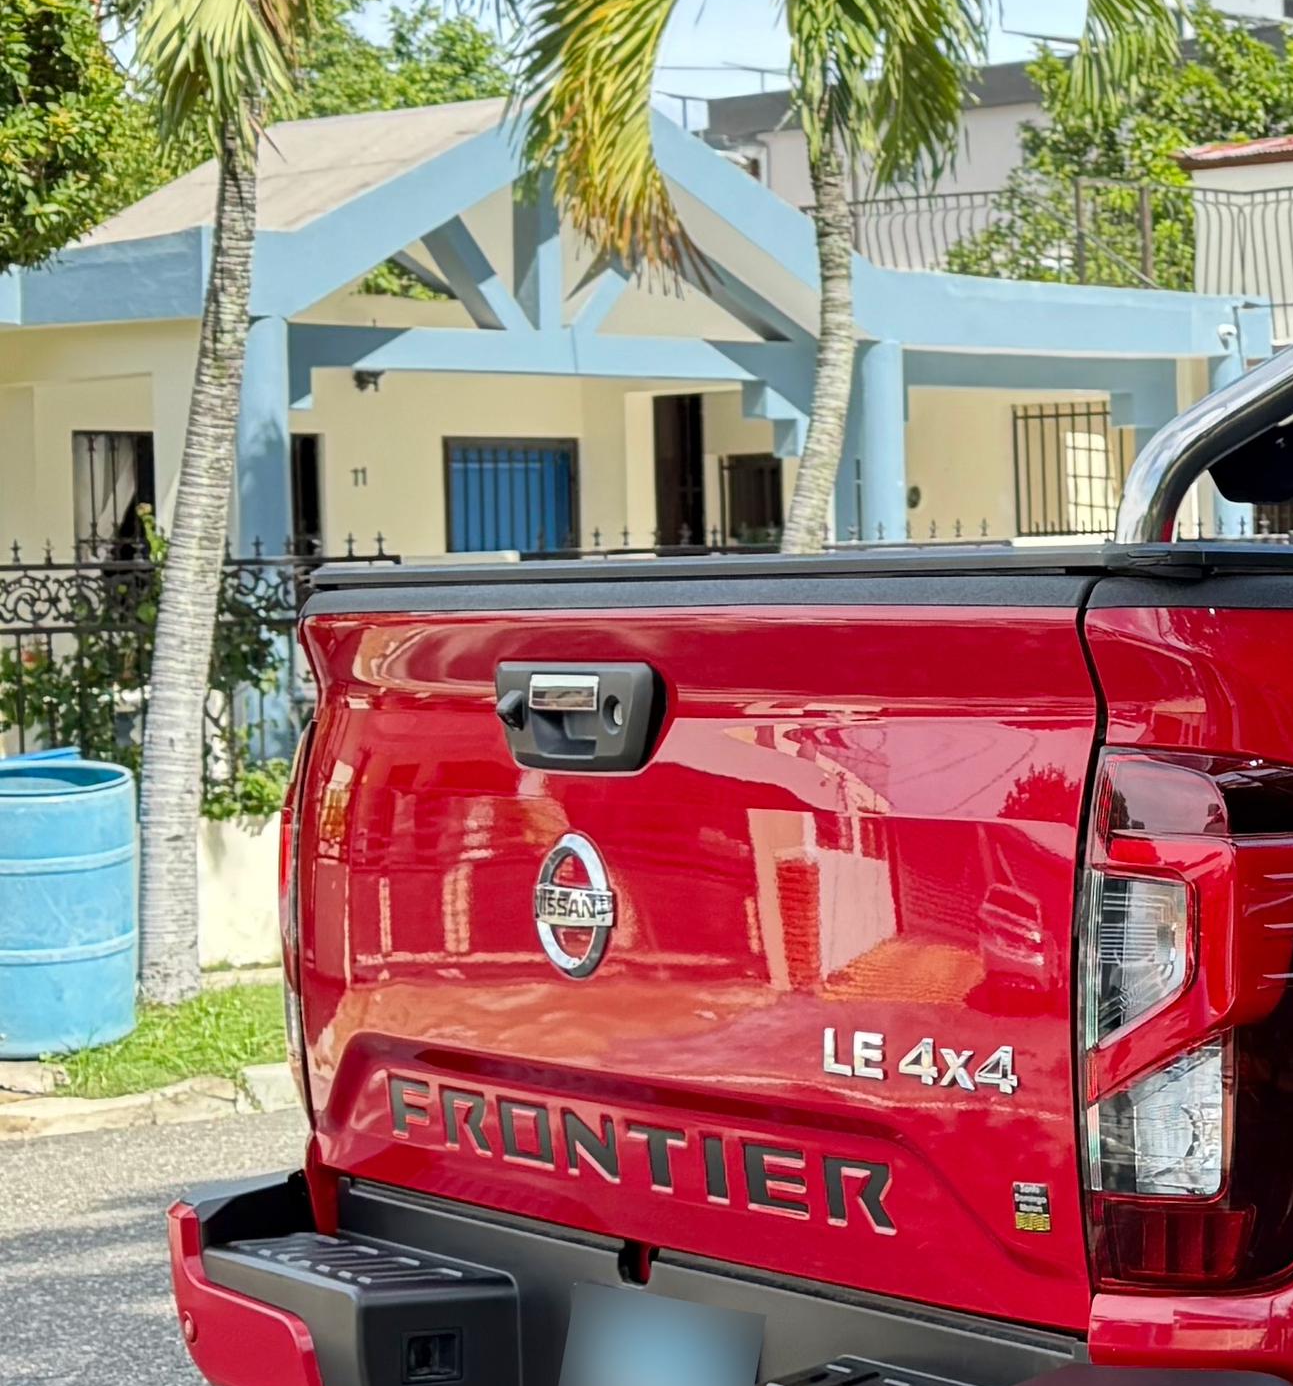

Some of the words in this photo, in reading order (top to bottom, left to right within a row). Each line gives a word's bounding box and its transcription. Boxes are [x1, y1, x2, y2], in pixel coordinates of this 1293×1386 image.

[350, 467, 367, 487] 11
[536, 893, 596, 918] NISSAN
[823, 1028, 885, 1080] LE
[898, 1038, 1018, 1095] 4x4
[388, 1074, 897, 1235] FRONTIER
